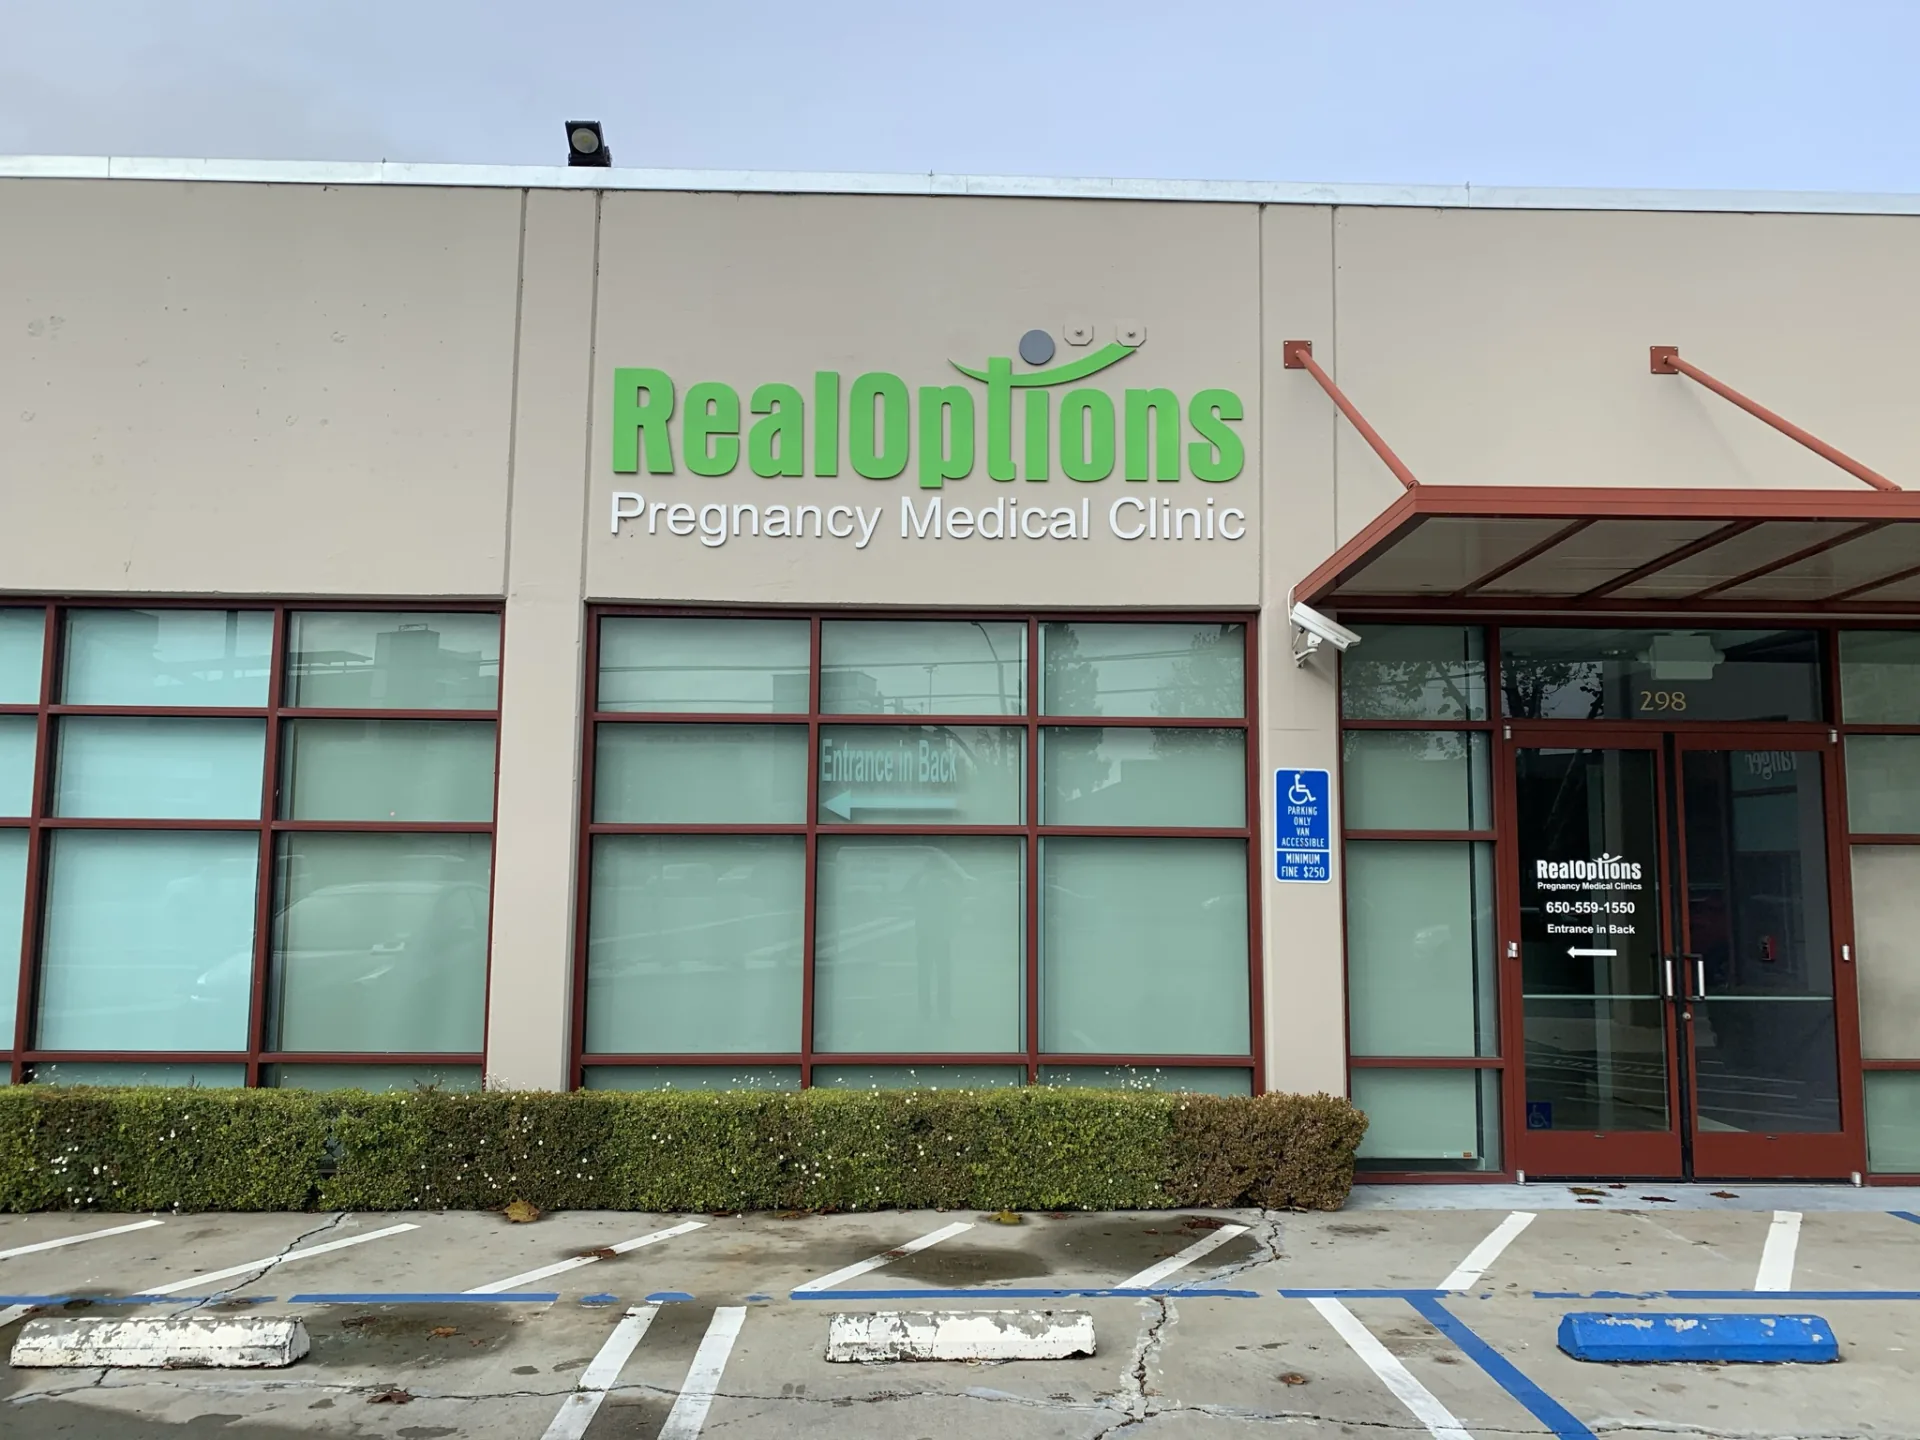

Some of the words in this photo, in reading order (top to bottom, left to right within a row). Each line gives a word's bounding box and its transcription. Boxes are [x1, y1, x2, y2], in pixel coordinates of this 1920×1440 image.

[612, 328, 1245, 489] RealOptions
[610, 491, 883, 549] Pregnancy
[900, 496, 1091, 540] Medical
[1108, 496, 1246, 541] Clinic
[1639, 691, 1687, 712] 298
[821, 738, 893, 783] Entrance
[898, 740, 912, 782] in
[918, 739, 957, 783] Back
[1287, 805, 1318, 816] PARKING
[1293, 816, 1312, 826] ONLY
[1296, 827, 1310, 837] VAN
[1281, 837, 1325, 848] ACCESSIBLE
[1285, 853, 1321, 865] MINIMUM
[1281, 865, 1299, 877] FINE
[1303, 866, 1325, 878] $250
[1536, 852, 1642, 881] RealOptions
[1537, 881, 1580, 891] Pregnancy
[1582, 881, 1613, 890] Medical
[1614, 881, 1643, 891] Clinics
[1546, 901, 1636, 914] 650-559-1550
[1547, 923, 1594, 934] Entrance
[1596, 924, 1607, 934] in
[1609, 924, 1636, 934] Back
